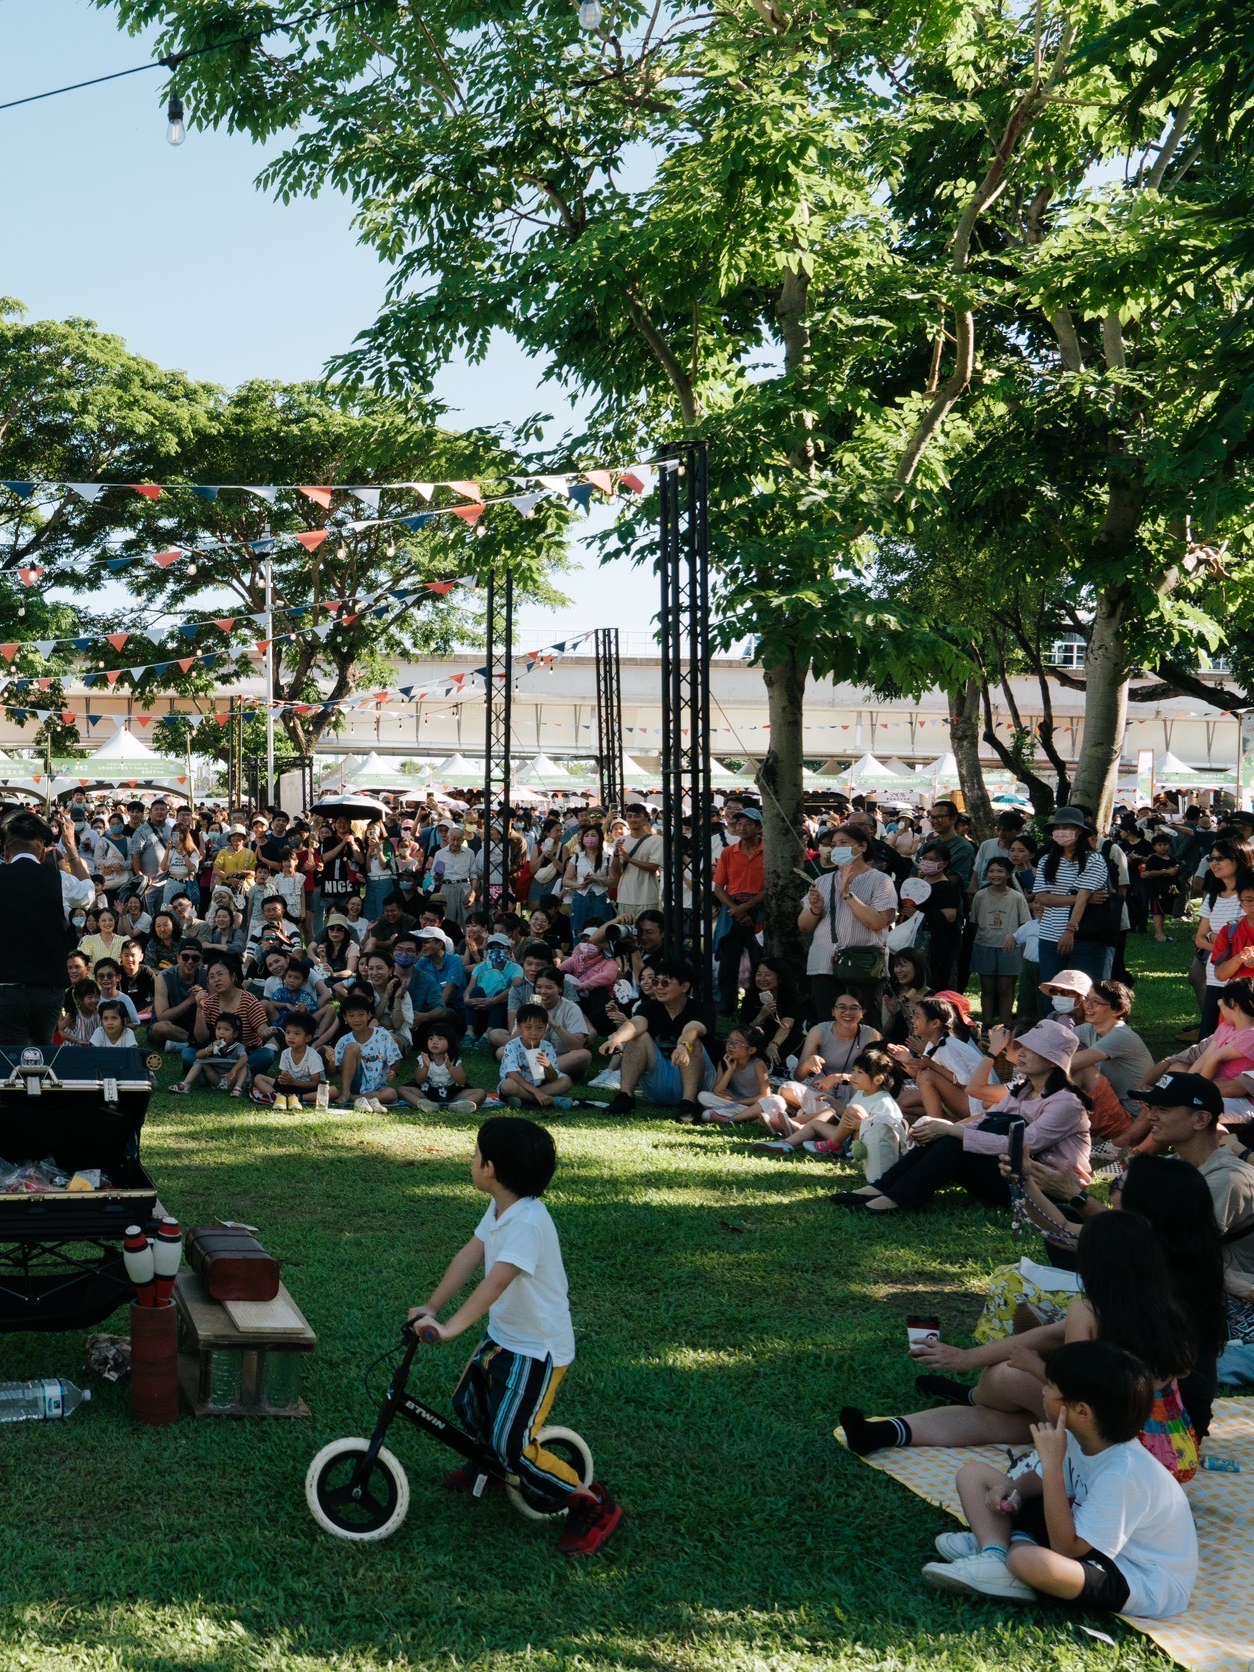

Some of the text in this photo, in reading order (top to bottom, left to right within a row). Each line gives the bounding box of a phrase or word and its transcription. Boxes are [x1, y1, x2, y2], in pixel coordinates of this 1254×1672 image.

[74, 764, 88, 772] #62
[324, 880, 353, 894] NICE
[404, 1400, 446, 1430] BTWIN
